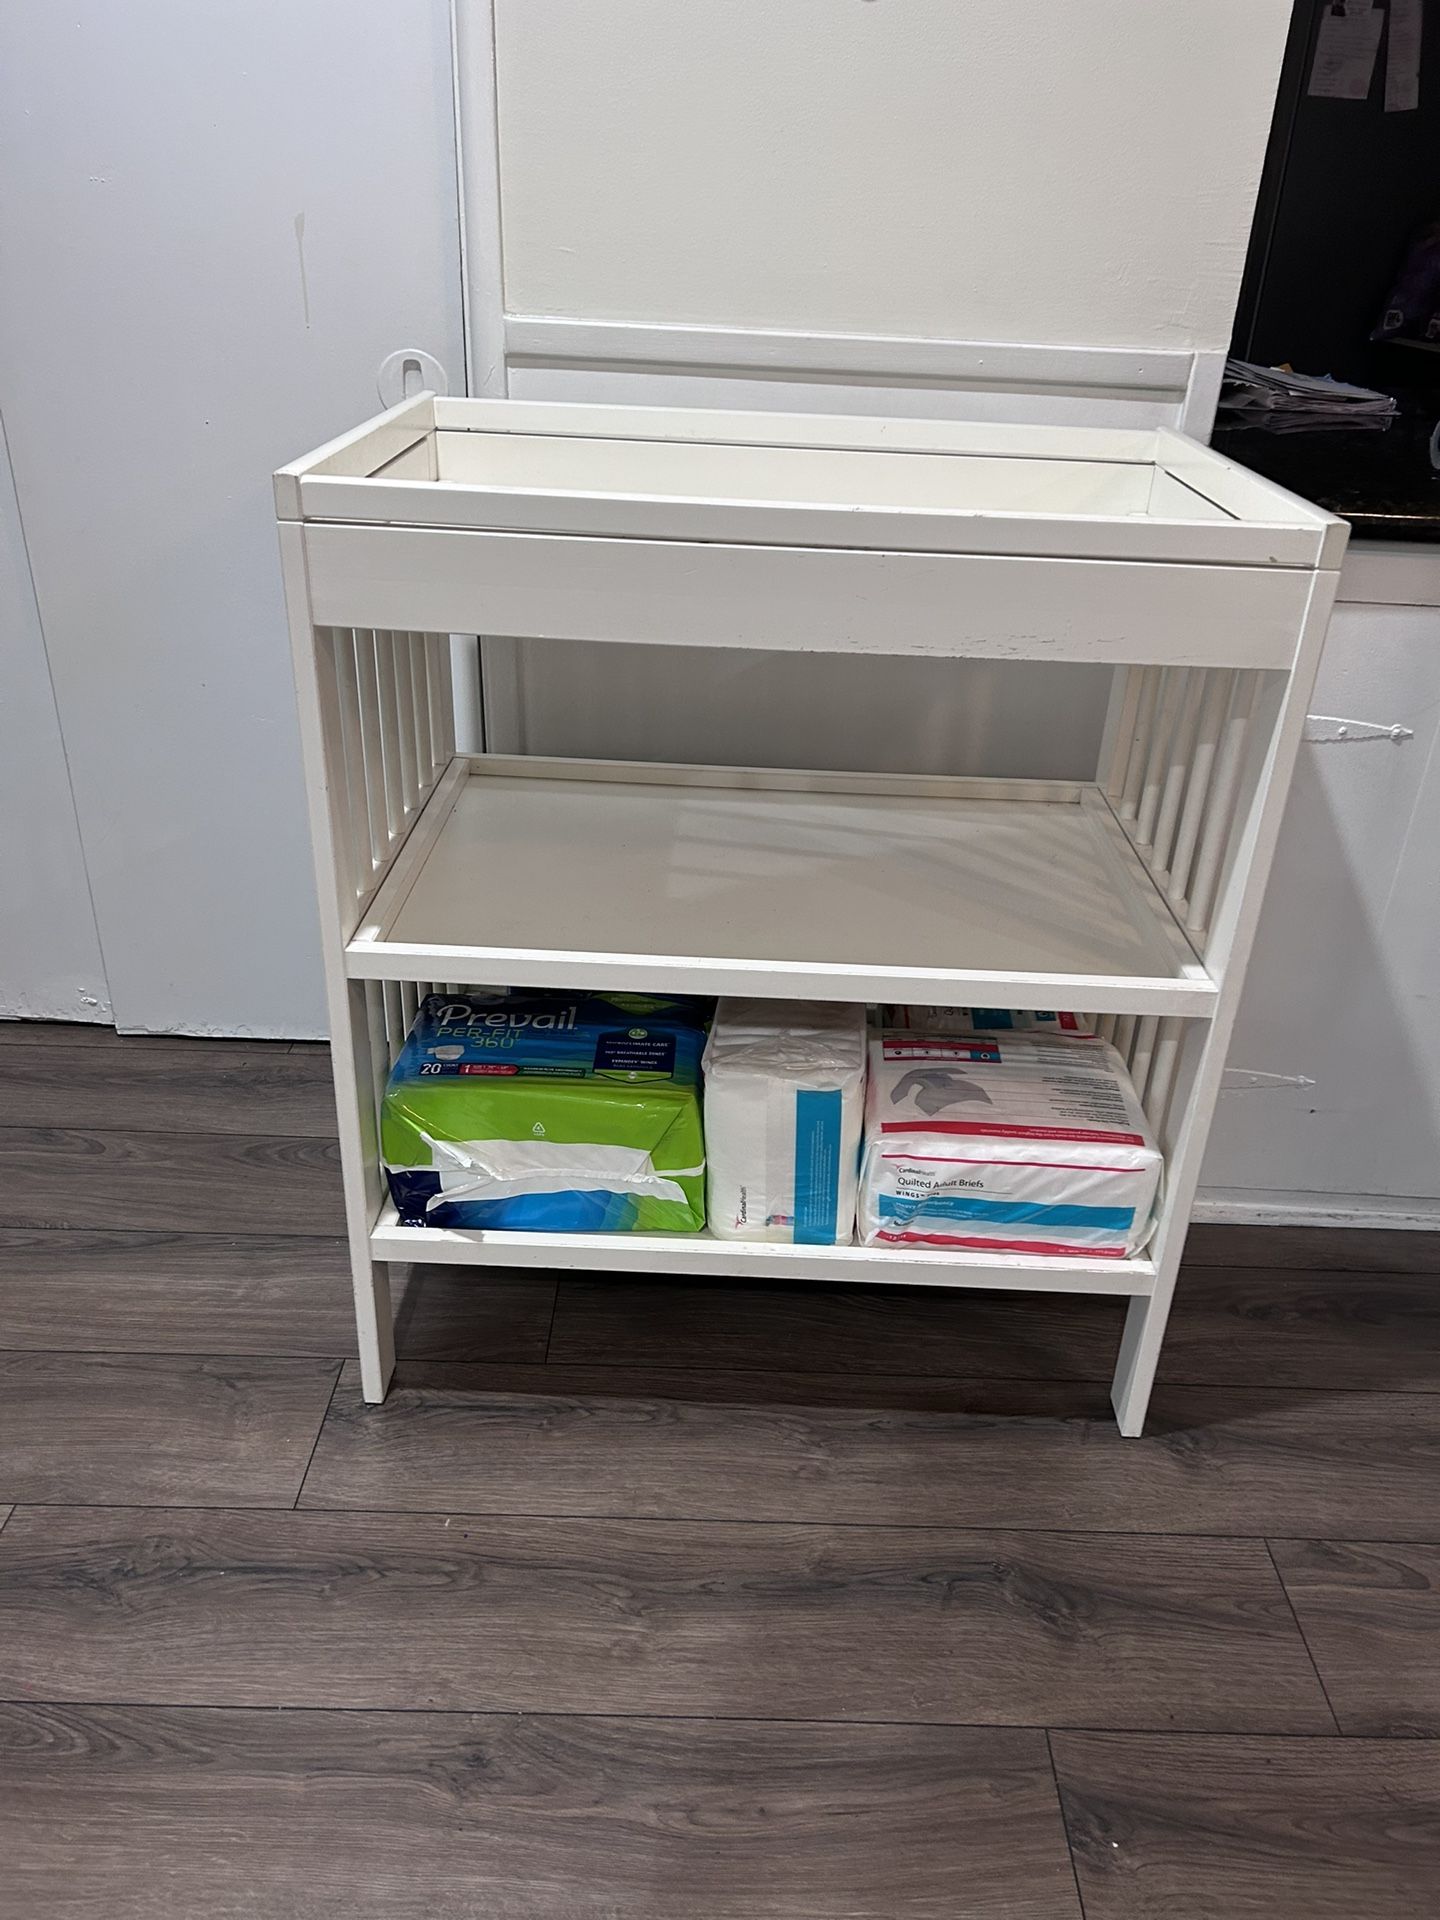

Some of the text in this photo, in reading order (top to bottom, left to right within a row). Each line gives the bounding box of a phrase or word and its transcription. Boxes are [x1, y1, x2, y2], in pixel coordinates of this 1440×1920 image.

[436, 1004, 577, 1030] Prevail
[436, 1027, 524, 1038] PER-FIT
[420, 1063, 442, 1075] 20
[464, 1064, 471, 1073] 1
[897, 1177, 931, 1189] Quilted
[958, 1179, 984, 1188] Briefs
